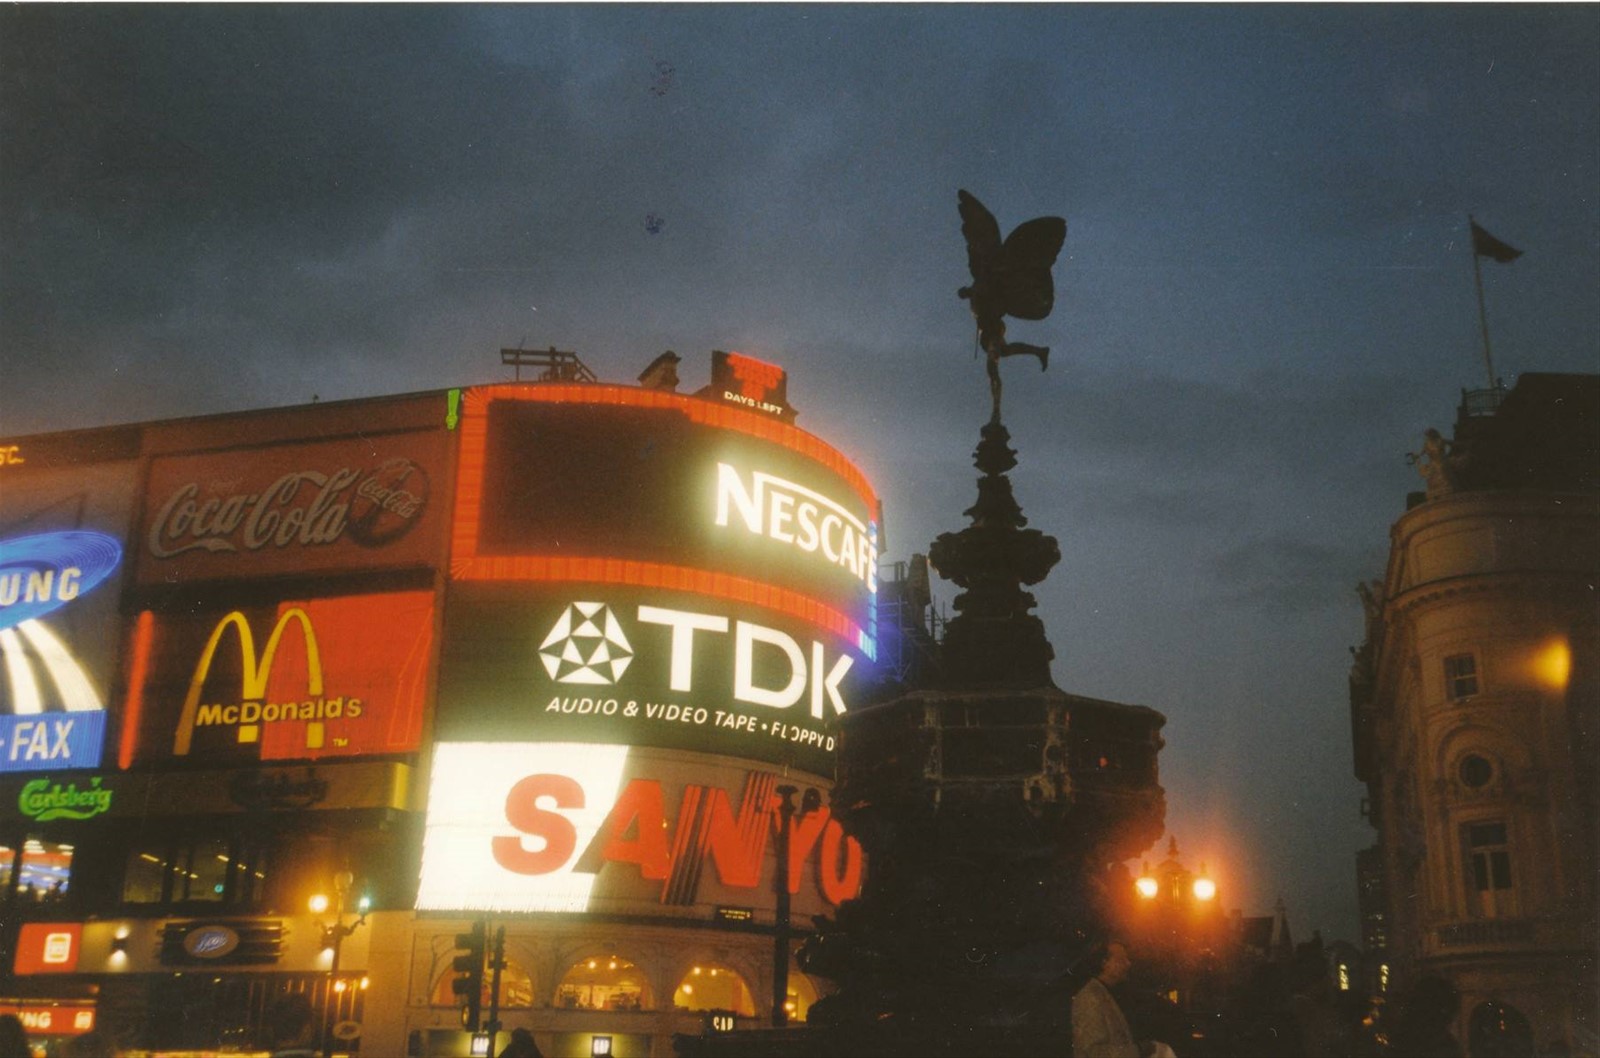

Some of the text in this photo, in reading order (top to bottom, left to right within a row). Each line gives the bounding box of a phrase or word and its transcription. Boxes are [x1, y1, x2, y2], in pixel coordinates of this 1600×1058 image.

[724, 391, 783, 415] DAYS LEFT
[638, 605, 854, 719] TDK
[197, 697, 362, 726] McDonald's
[546, 697, 618, 715] AUDIO
[622, 701, 639, 717] &
[646, 703, 708, 724] VIDEO
[714, 711, 758, 732] TAPE
[10, 719, 74, 760] FAX
[18, 777, 113, 821] Carlsberg
[491, 770, 862, 905] SANYO
